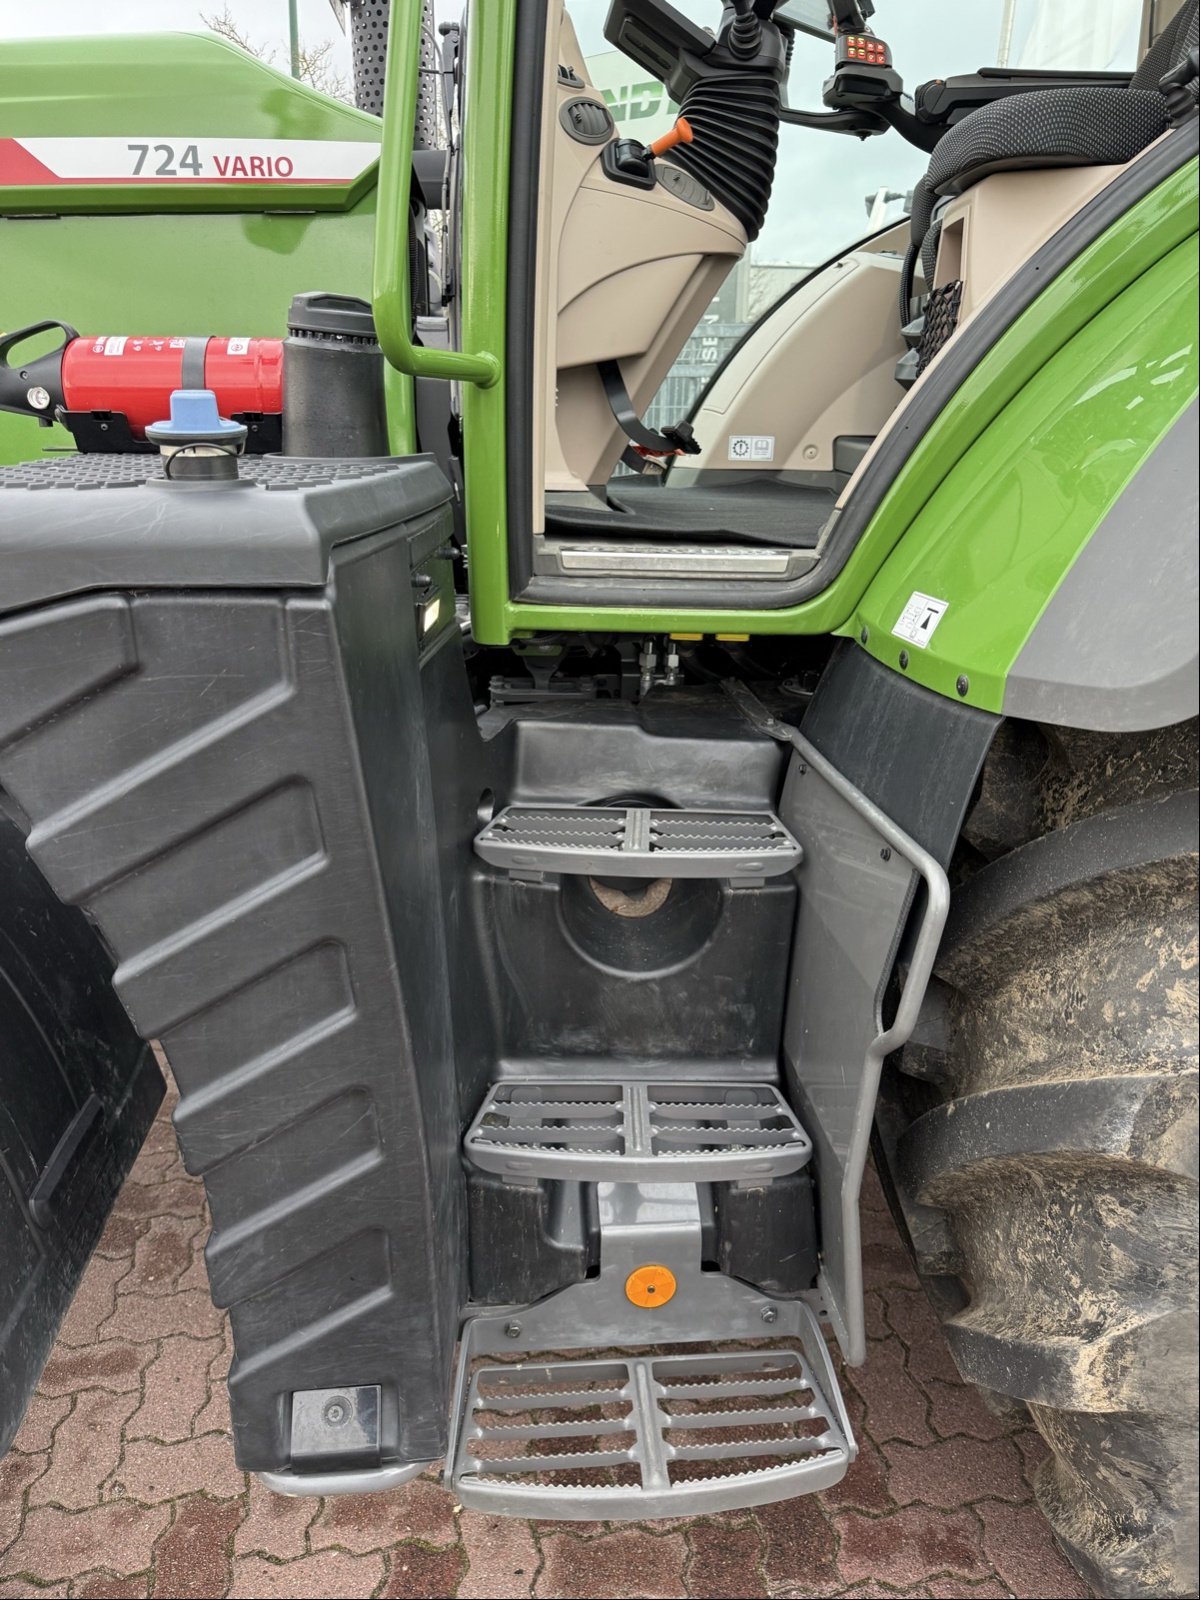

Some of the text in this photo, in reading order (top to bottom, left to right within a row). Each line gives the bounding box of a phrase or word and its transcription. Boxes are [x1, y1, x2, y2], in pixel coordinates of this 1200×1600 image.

[601, 81, 681, 122] ND
[127, 144, 294, 177] 724 VARIO
